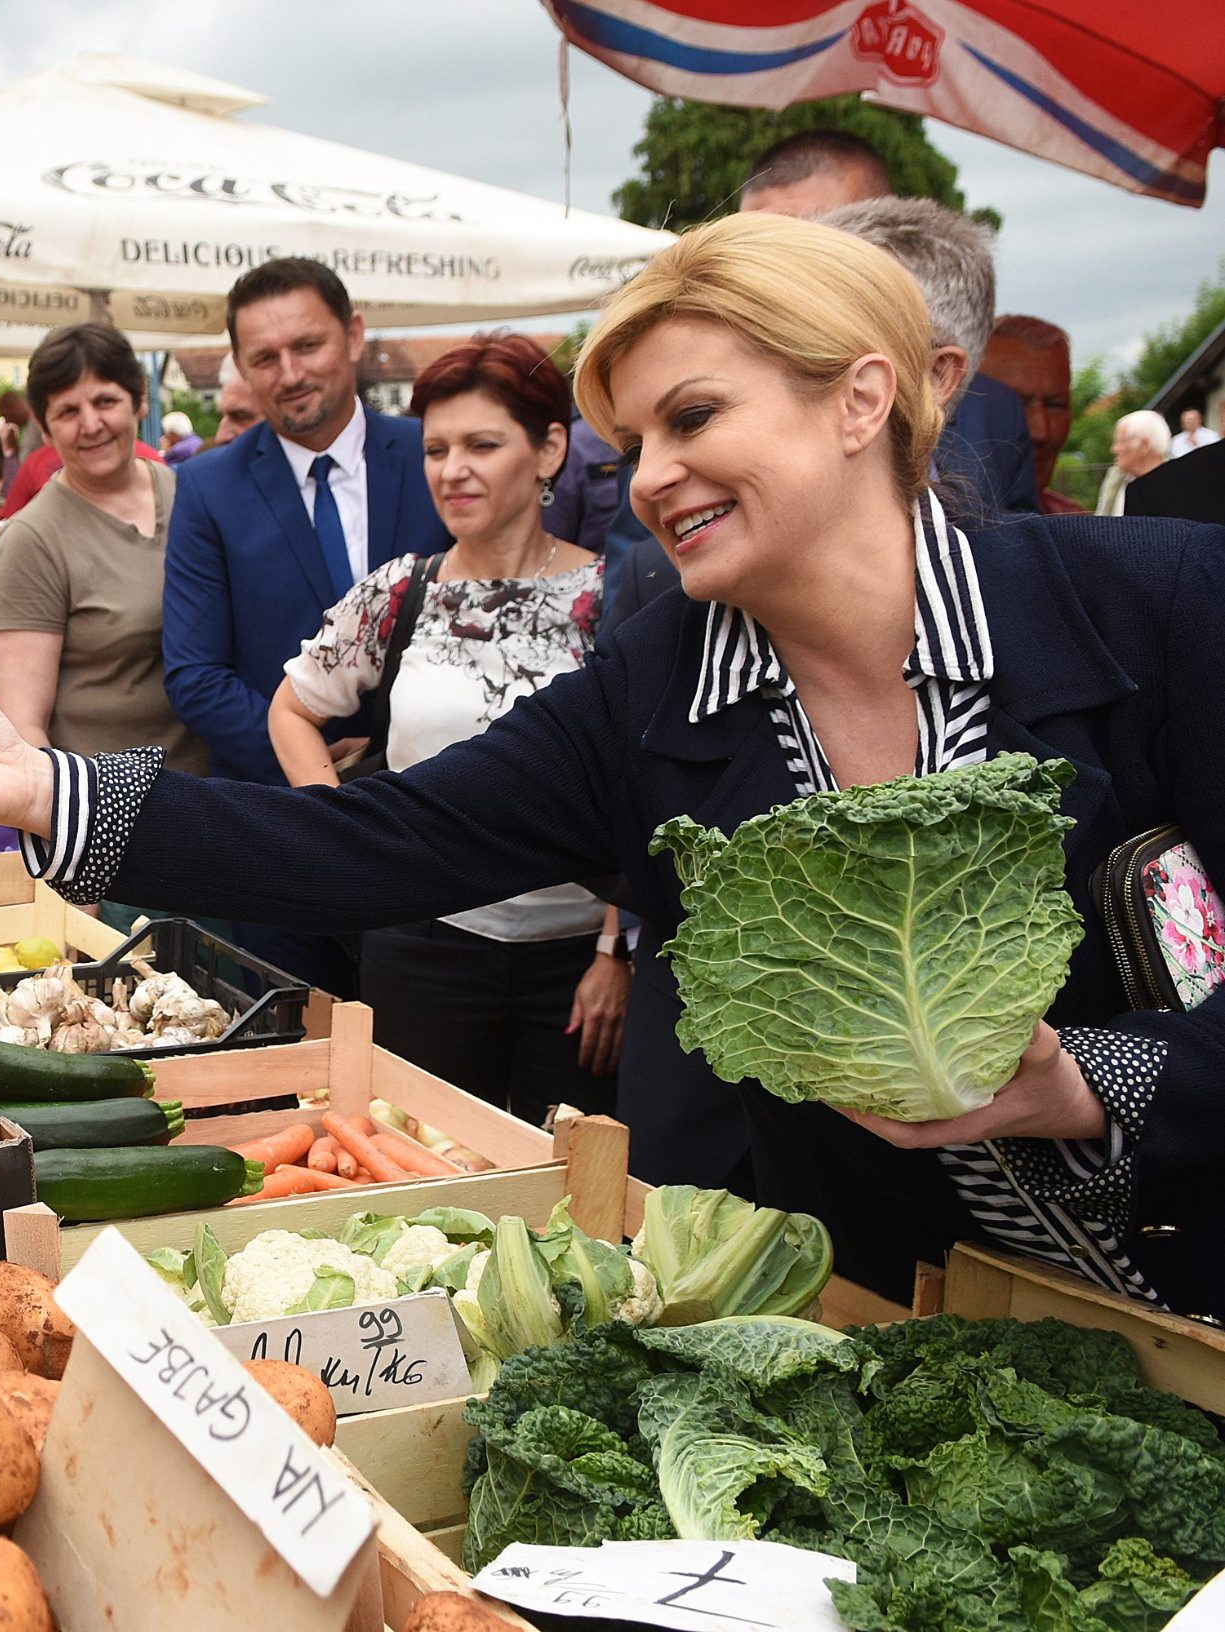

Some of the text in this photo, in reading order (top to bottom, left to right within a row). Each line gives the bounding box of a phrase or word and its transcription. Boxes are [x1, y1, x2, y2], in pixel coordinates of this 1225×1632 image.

[120, 237, 281, 268] DELICIOUS
[333, 248, 502, 281] REFRESHING
[358, 1308, 403, 1343] 99
[128, 1328, 347, 1538] NA GAJBE
